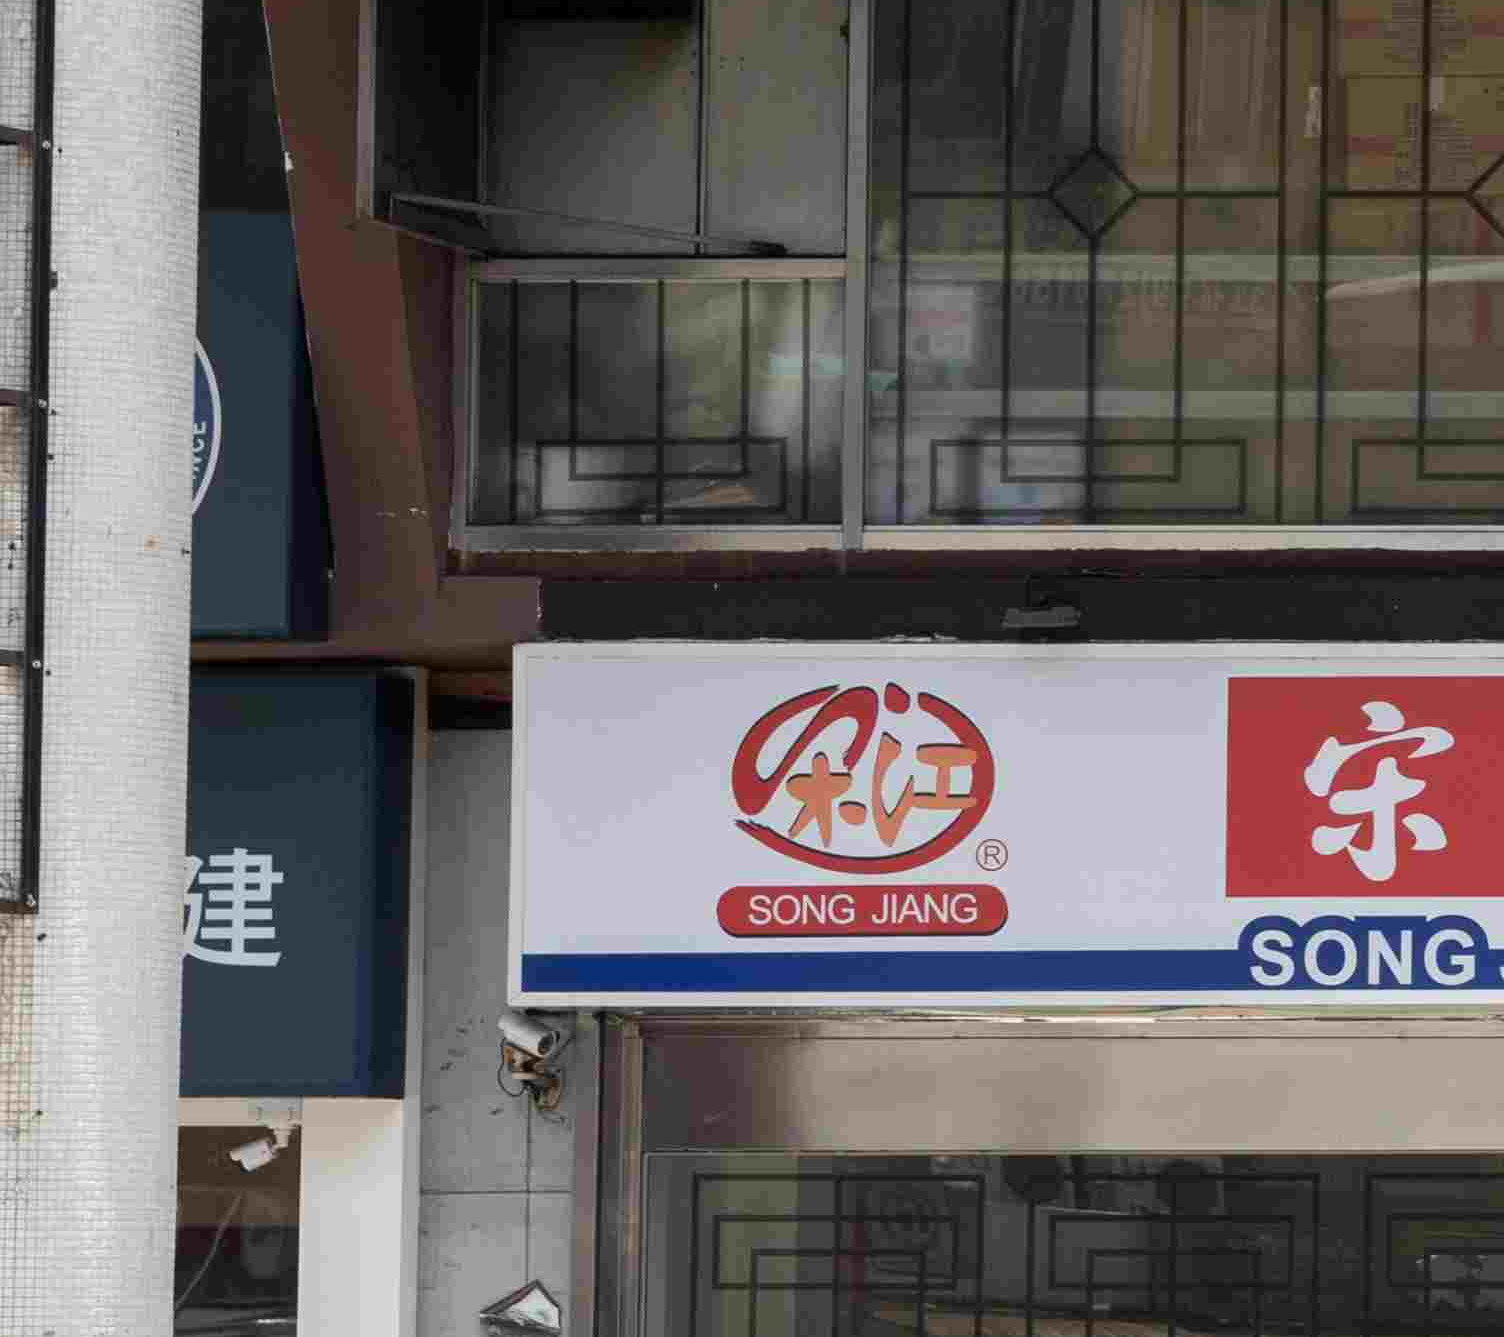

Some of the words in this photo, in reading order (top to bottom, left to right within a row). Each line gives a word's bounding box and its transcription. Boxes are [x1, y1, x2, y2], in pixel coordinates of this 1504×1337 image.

[748, 893, 854, 927] SONG
[871, 893, 978, 927] JIANG
[1248, 929, 1477, 987] SONG
